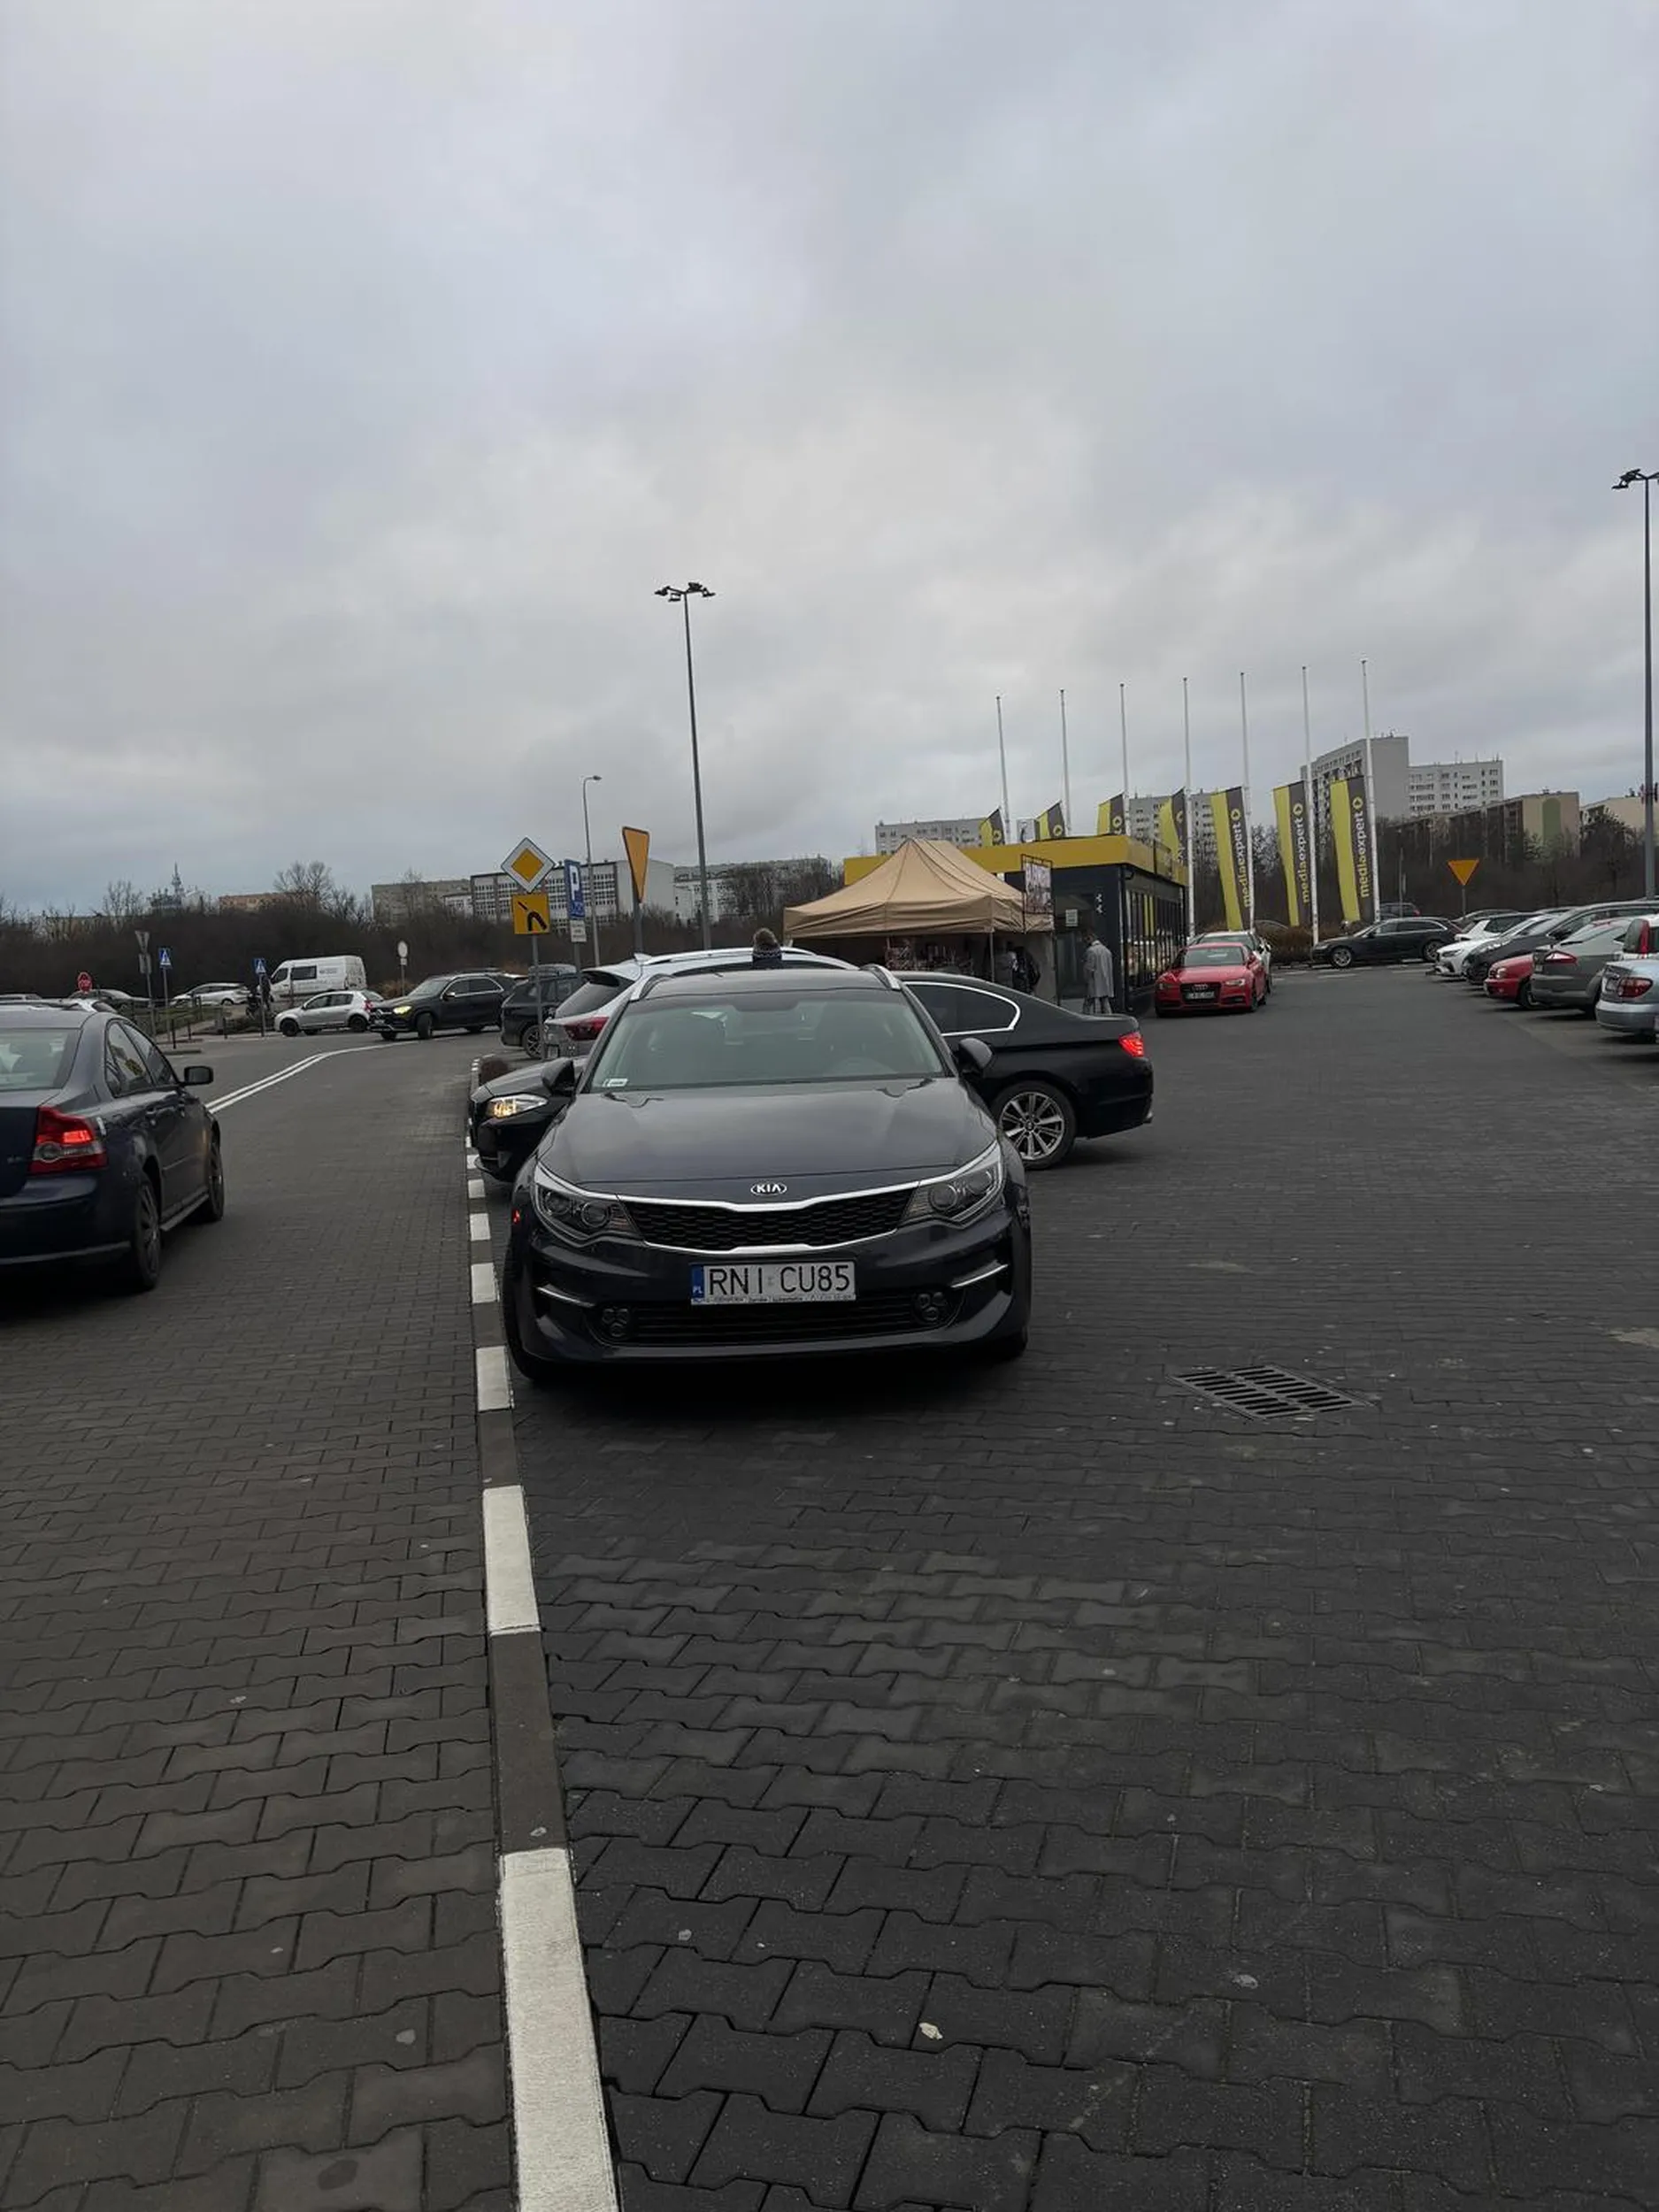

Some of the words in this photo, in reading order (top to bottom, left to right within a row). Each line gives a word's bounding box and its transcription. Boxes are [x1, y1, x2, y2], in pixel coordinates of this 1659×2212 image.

[1355, 810, 1370, 897] mediaexpert
[569, 864, 580, 901] P
[756, 1183, 782, 1194] KIA
[693, 1286, 703, 1294] PL
[709, 1267, 764, 1296] RNI
[780, 1264, 850, 1294] CU85
